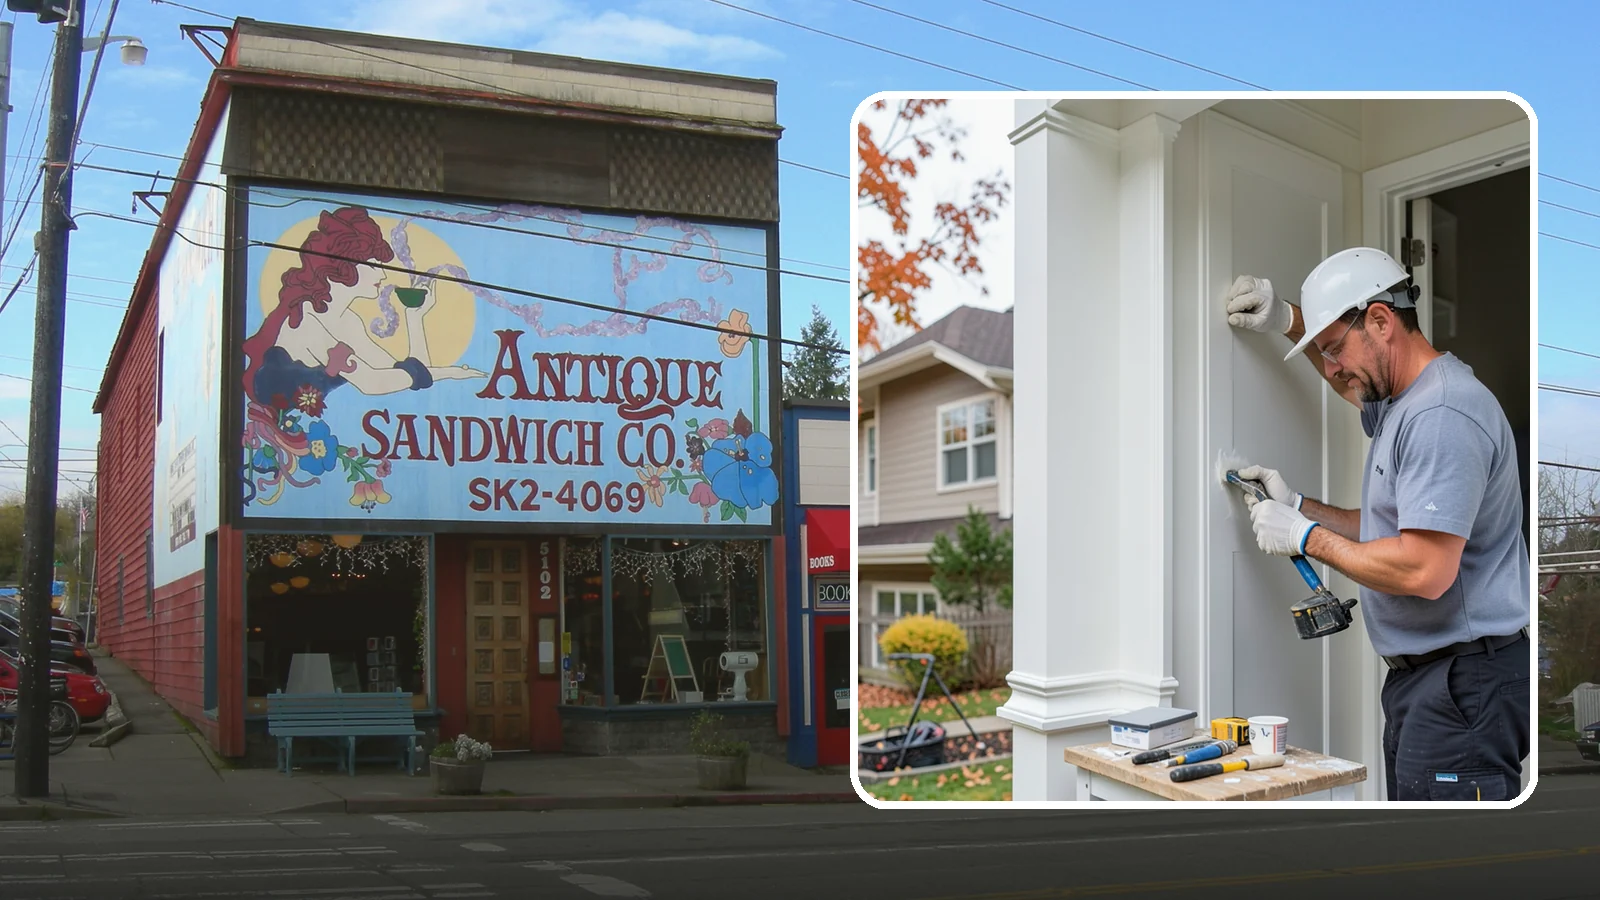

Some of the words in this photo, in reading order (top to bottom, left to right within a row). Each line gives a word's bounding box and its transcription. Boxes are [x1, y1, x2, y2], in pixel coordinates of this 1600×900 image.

[476, 329, 723, 420] ANTIQUE
[361, 409, 605, 467] SANDWICH
[617, 421, 685, 468] CO.
[468, 477, 645, 513] SK2-4069
[539, 542, 551, 599] 5102
[809, 555, 835, 569] BOOKS
